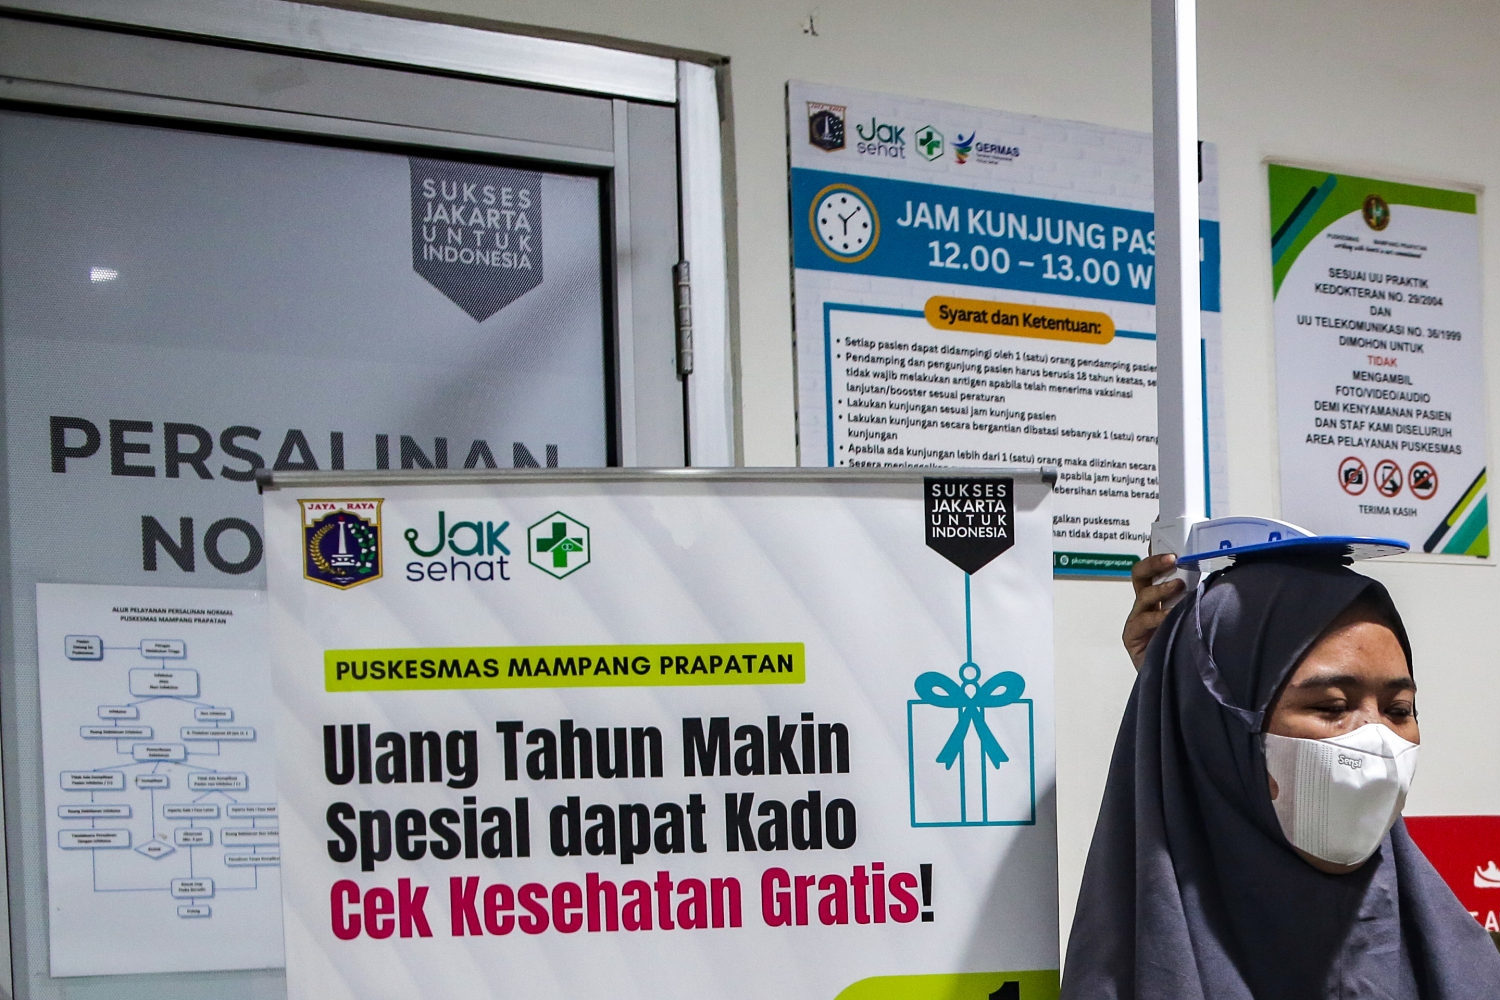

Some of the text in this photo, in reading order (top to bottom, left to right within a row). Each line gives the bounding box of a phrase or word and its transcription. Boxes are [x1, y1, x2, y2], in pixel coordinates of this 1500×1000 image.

[856, 117, 905, 144] Jak
[857, 140, 905, 158] sehat
[976, 142, 1019, 158] GERMAS
[422, 179, 531, 208] SUKSES
[424, 202, 531, 231] JAKARTA
[897, 200, 1105, 250] JAM KUNJUNG
[424, 228, 532, 253] UNTUK
[423, 246, 532, 270] INDONESIA
[928, 241, 1120, 286] 12.00 13.00
[1329, 268, 1428, 288] SESUAI UU PRAKTIK
[939, 305, 1101, 335] Syarat dan Ketentuan:
[1370, 306, 1391, 317] DAN
[1297, 315, 1312, 325] UU
[1315, 316, 1404, 335] TELEKOMUNIKASI
[1407, 323, 1424, 337] NO.
[1339, 336, 1424, 353] DIMOHON UNTUK
[1368, 356, 1397, 367] TIDAK
[1353, 371, 1413, 385] MENGAMBIL
[847, 398, 1056, 421] Lakukan kunjungan sesuai jam kunjung pasien
[1315, 401, 1451, 421] DEMI KENYAMANAN PASIEN
[1315, 417, 1452, 437] DAN STAF KAMI DISELURUH
[1306, 434, 1462, 454] AREA PELAYANAN PUSKESMAS
[932, 484, 1006, 497] SUKSES
[932, 499, 1006, 513] JAKARTA
[1359, 505, 1417, 516] TERIMA KASIH
[932, 514, 1007, 526] UNTUK
[404, 511, 510, 557] Jak
[932, 526, 1007, 538] INDONESIA
[406, 556, 510, 581] sehat
[336, 653, 793, 680] PUSKESMAS MAMPANG PRAPATAN
[324, 724, 478, 789] Ulang
[496, 716, 664, 782] Tahun
[682, 712, 851, 778] Makin
[327, 796, 530, 871] Spesial
[549, 794, 707, 865] dapat
[726, 789, 858, 852] Kado
[330, 863, 934, 941] Cek Kesehatan Gratis!
